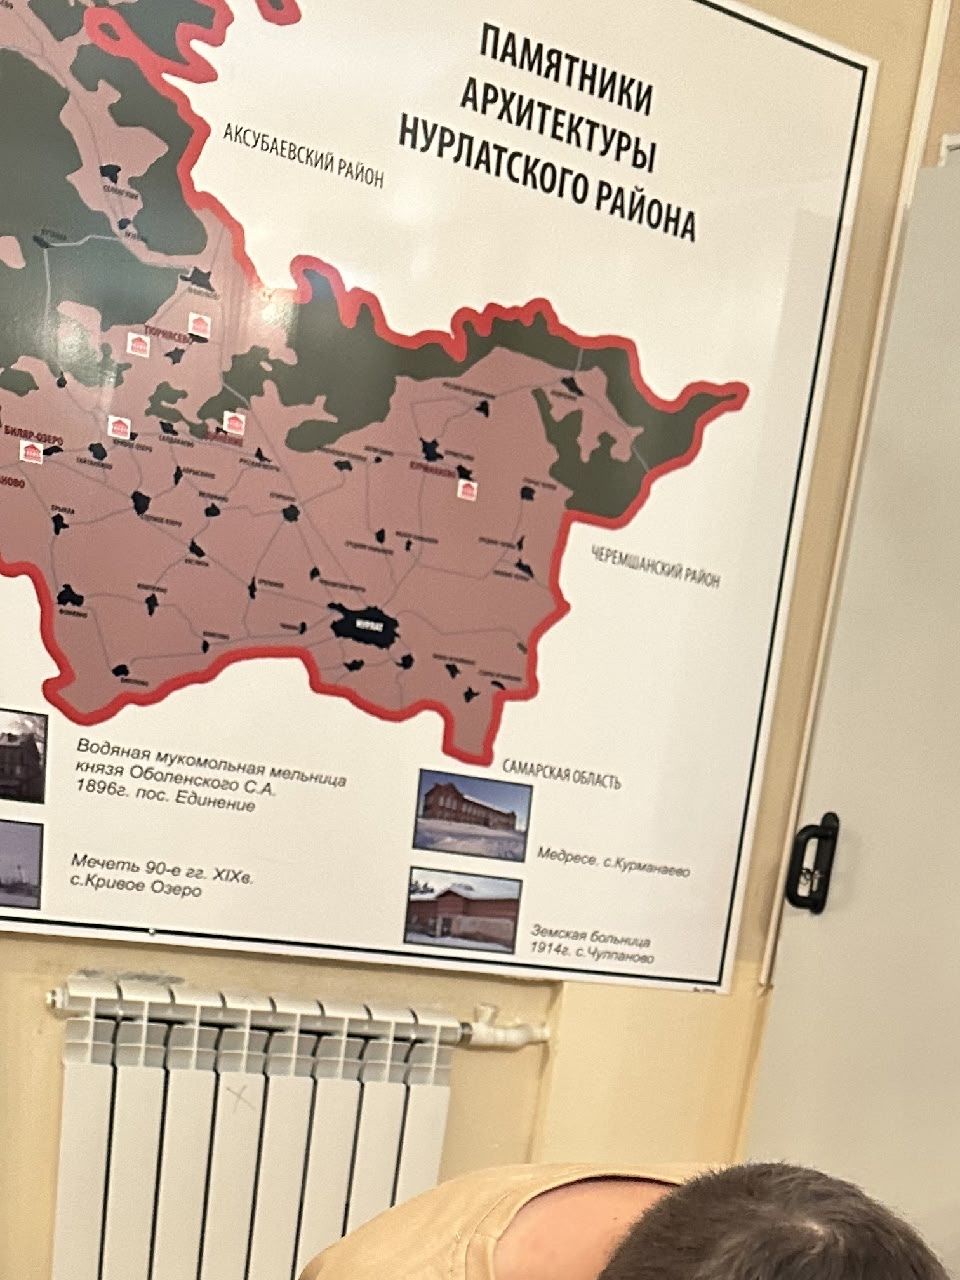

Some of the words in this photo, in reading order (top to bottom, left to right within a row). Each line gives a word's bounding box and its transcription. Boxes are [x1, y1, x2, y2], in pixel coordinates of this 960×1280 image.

[480, 23, 653, 116] ПАМЯТНИКИ
[460, 77, 657, 173] АРХИТЕКТУРЫ
[224, 123, 334, 173] АКСУБАЕВСКИЙ
[338, 159, 385, 189] РАЙОН
[399, 113, 589, 204] НУРЛАТСКОГО
[596, 180, 696, 242] РАЙОНА
[592, 545, 683, 579] ЧЕРЕМШАНСКИЙ
[684, 567, 721, 588] РАЙОН
[76, 761, 124, 777] князя
[130, 764, 239, 792] Оболенского
[244, 779, 276, 797] С.А.
[77, 738, 151, 761] Водяная
[156, 751, 265, 777] мукомольная
[269, 768, 347, 788] мельница
[502, 759, 570, 781] САМАРСКАЯ
[573, 769, 622, 790] ОБЛАСТЬ
[77, 779, 129, 798] 1896г.
[135, 788, 169, 803] пос.
[175, 792, 256, 813] Единение
[72, 853, 140, 873] Мечеть
[146, 861, 181, 878] 90-е
[186, 868, 207, 880] гг.
[70, 874, 145, 895] с.Кривое
[151, 881, 202, 899] Озеро
[531, 925, 587, 942] Земская
[590, 929, 651, 948] больница
[531, 941, 570, 957] 1914г.
